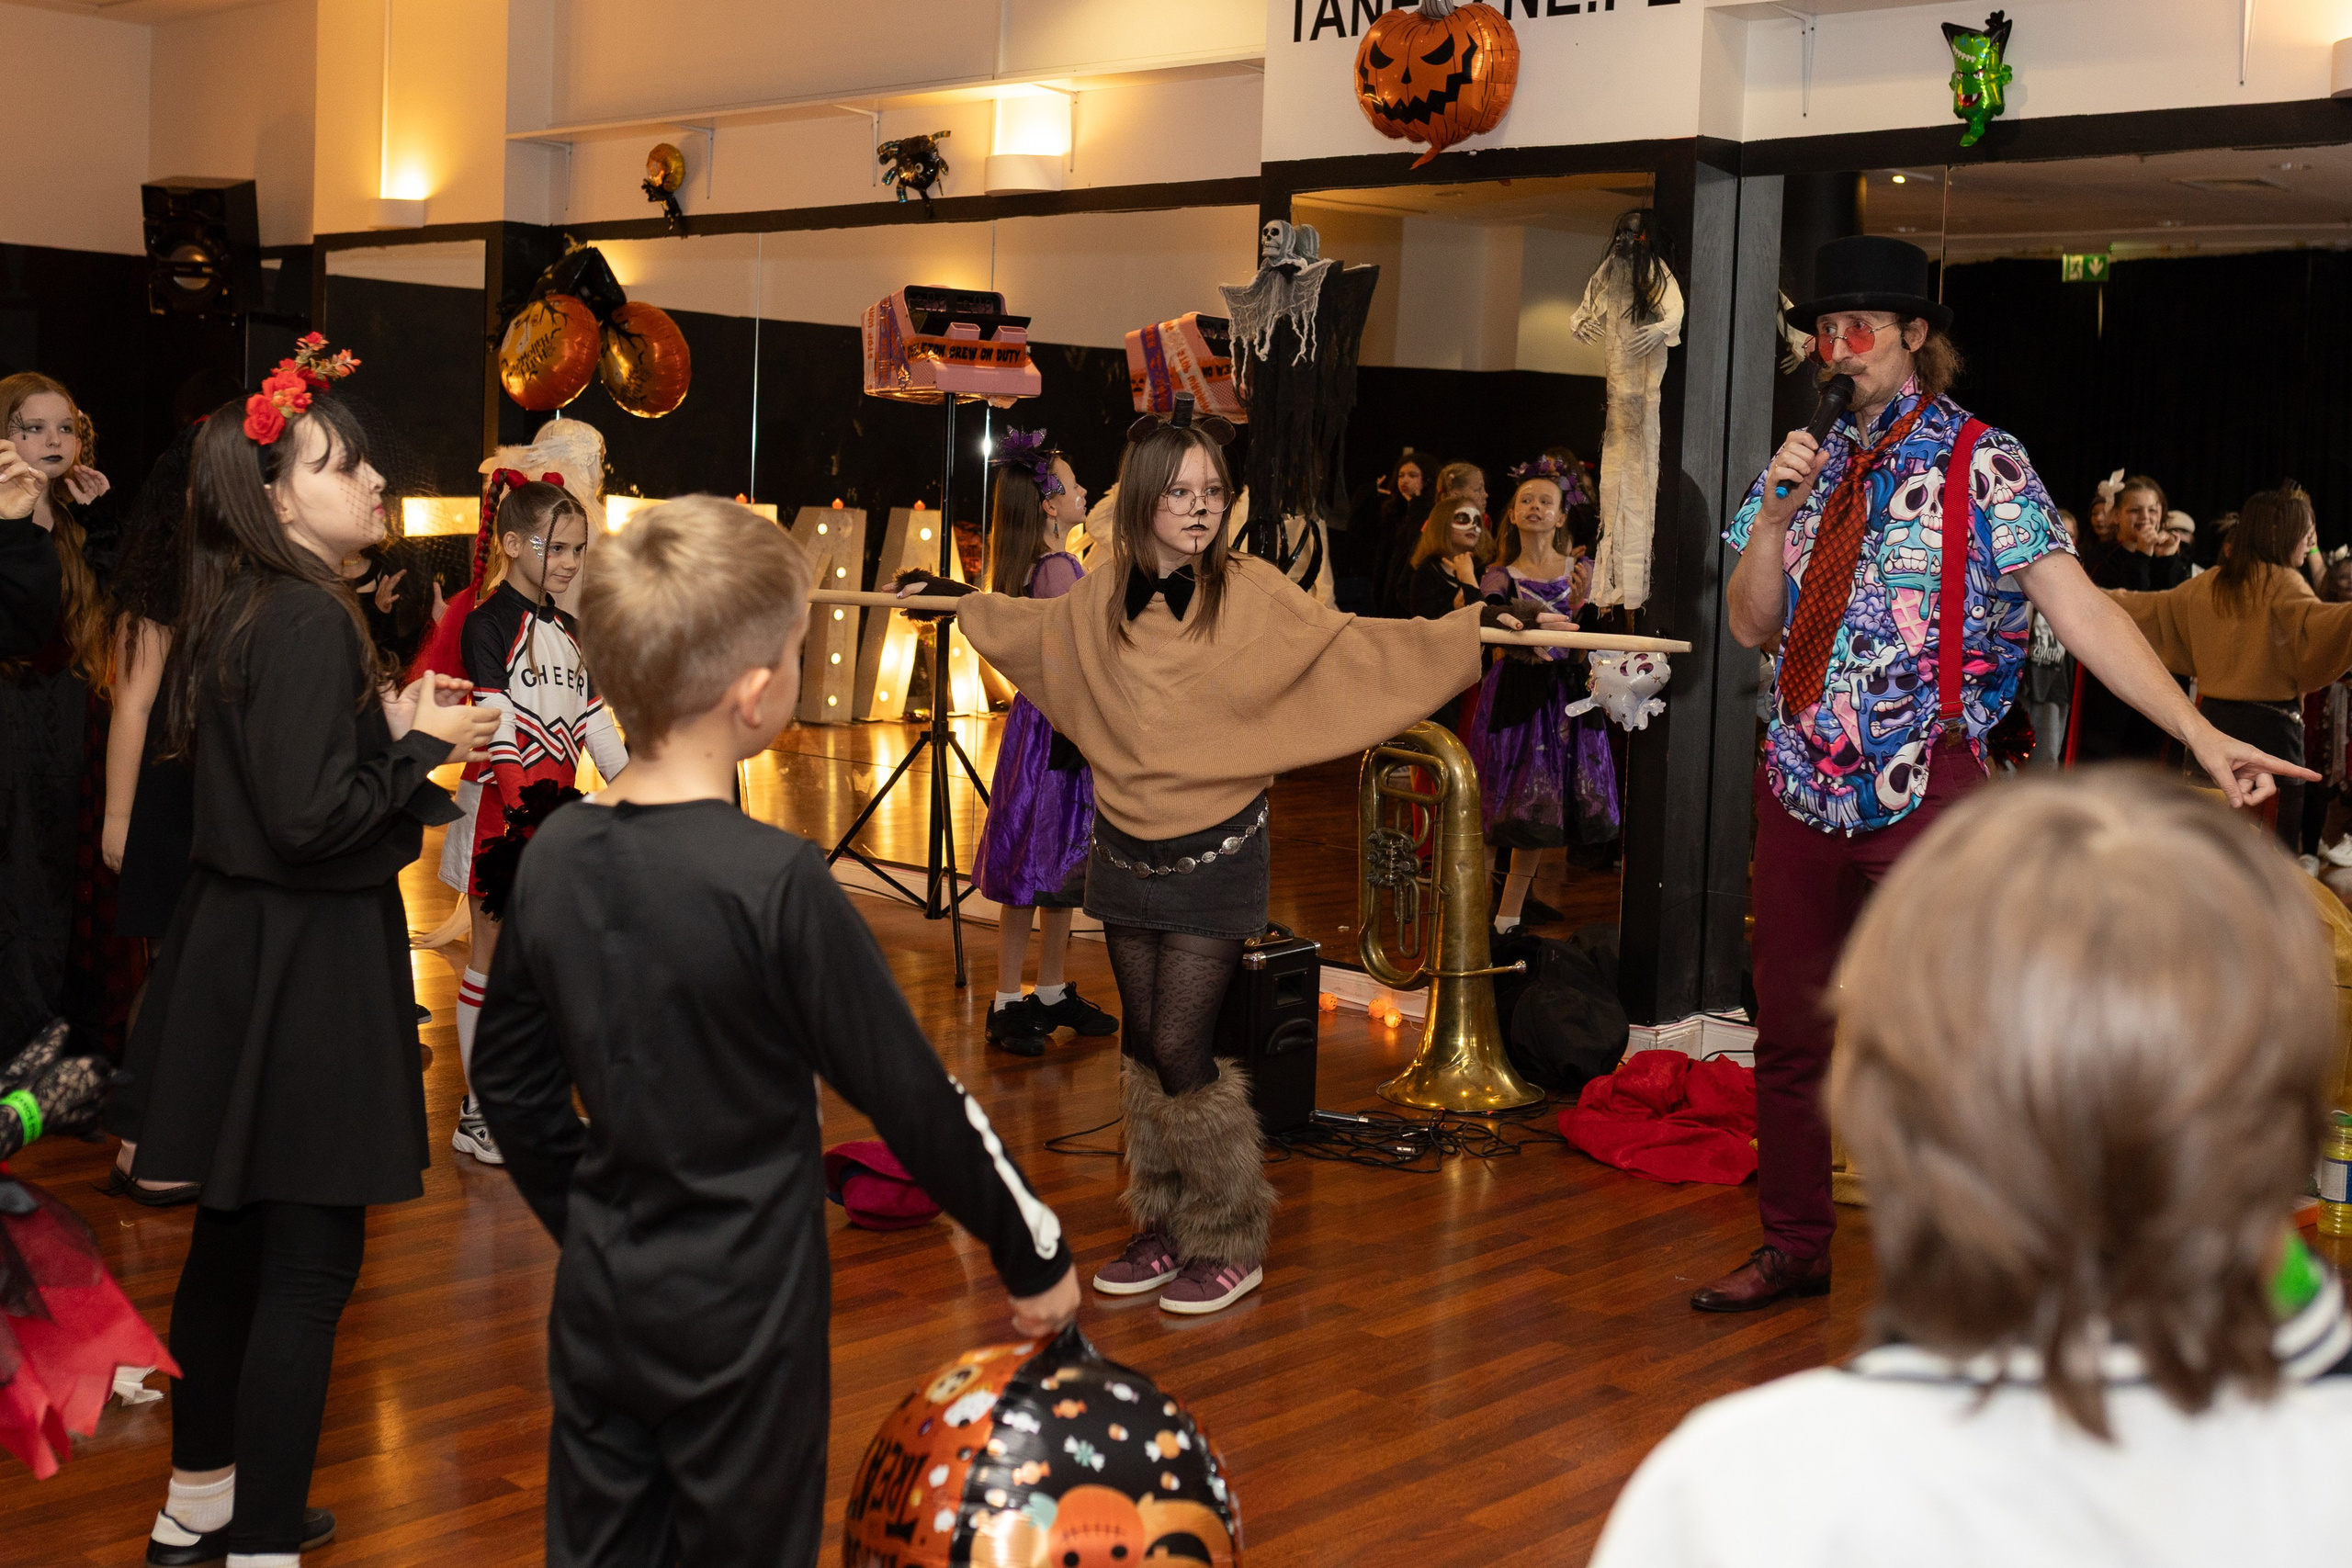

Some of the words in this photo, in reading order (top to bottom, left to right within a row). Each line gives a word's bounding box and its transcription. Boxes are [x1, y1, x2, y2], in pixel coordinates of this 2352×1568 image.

[949, 345, 978, 360] CREW
[980, 347, 993, 361] ON
[996, 349, 1021, 363] DUTY
[521, 664, 585, 697] CHEER
